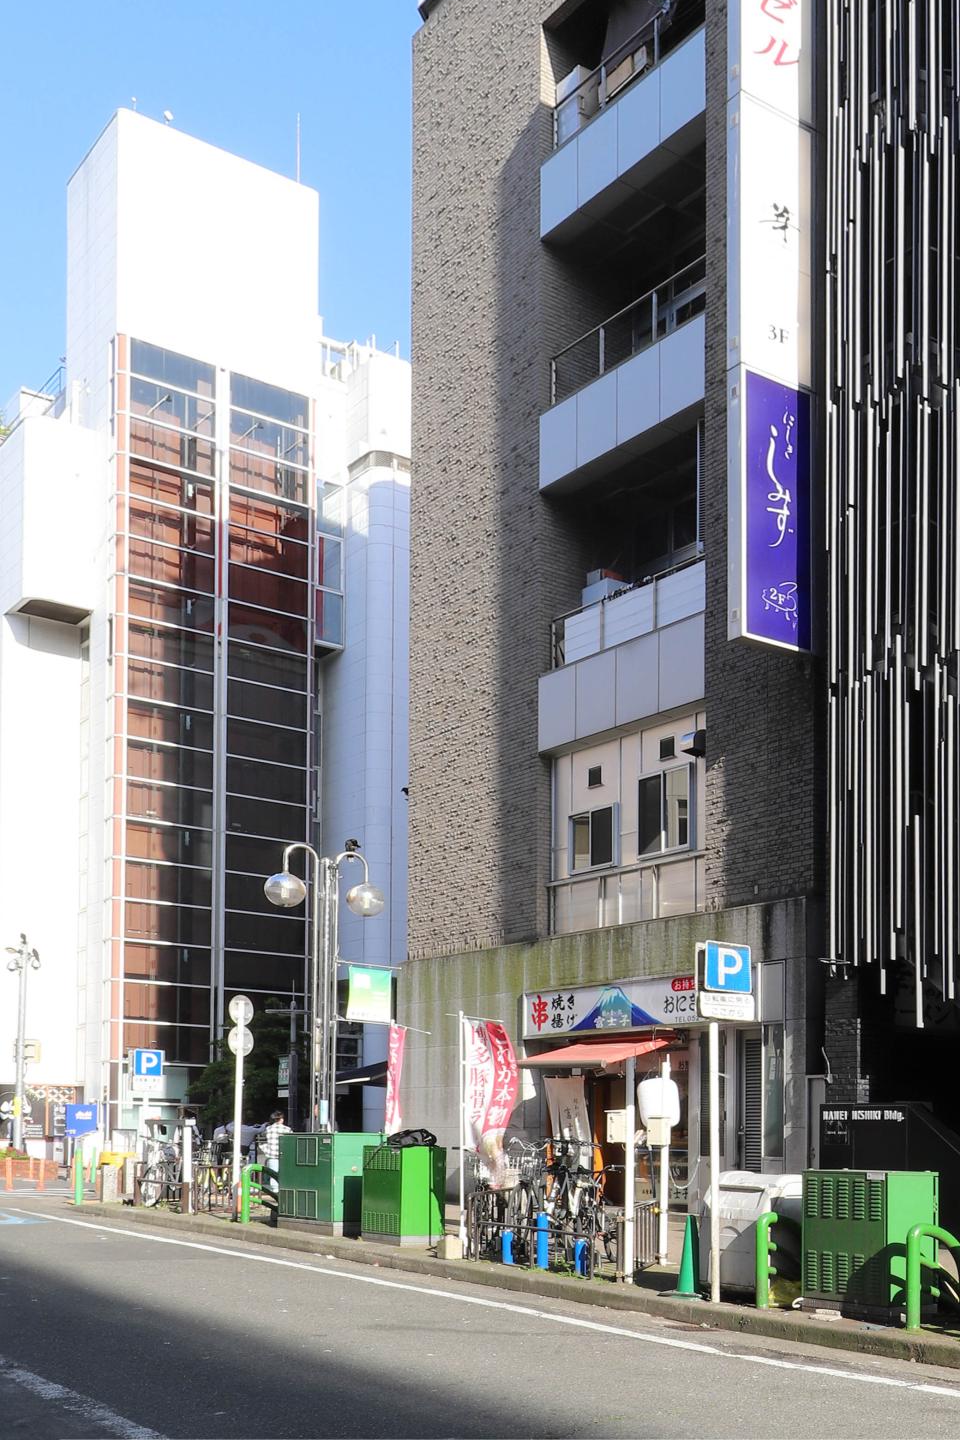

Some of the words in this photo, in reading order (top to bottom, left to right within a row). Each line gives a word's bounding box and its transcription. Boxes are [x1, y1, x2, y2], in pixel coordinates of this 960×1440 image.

[767, 323, 790, 345] 3F
[768, 586, 786, 606] 2F
[717, 947, 743, 985] P
[531, 993, 549, 1032] 串
[551, 993, 576, 1011] 焼き
[551, 1013, 578, 1029] 揚げ
[141, 1052, 158, 1074] P
[851, 1110, 881, 1121] NISHIKI
[884, 1109, 905, 1122] Bldg.
